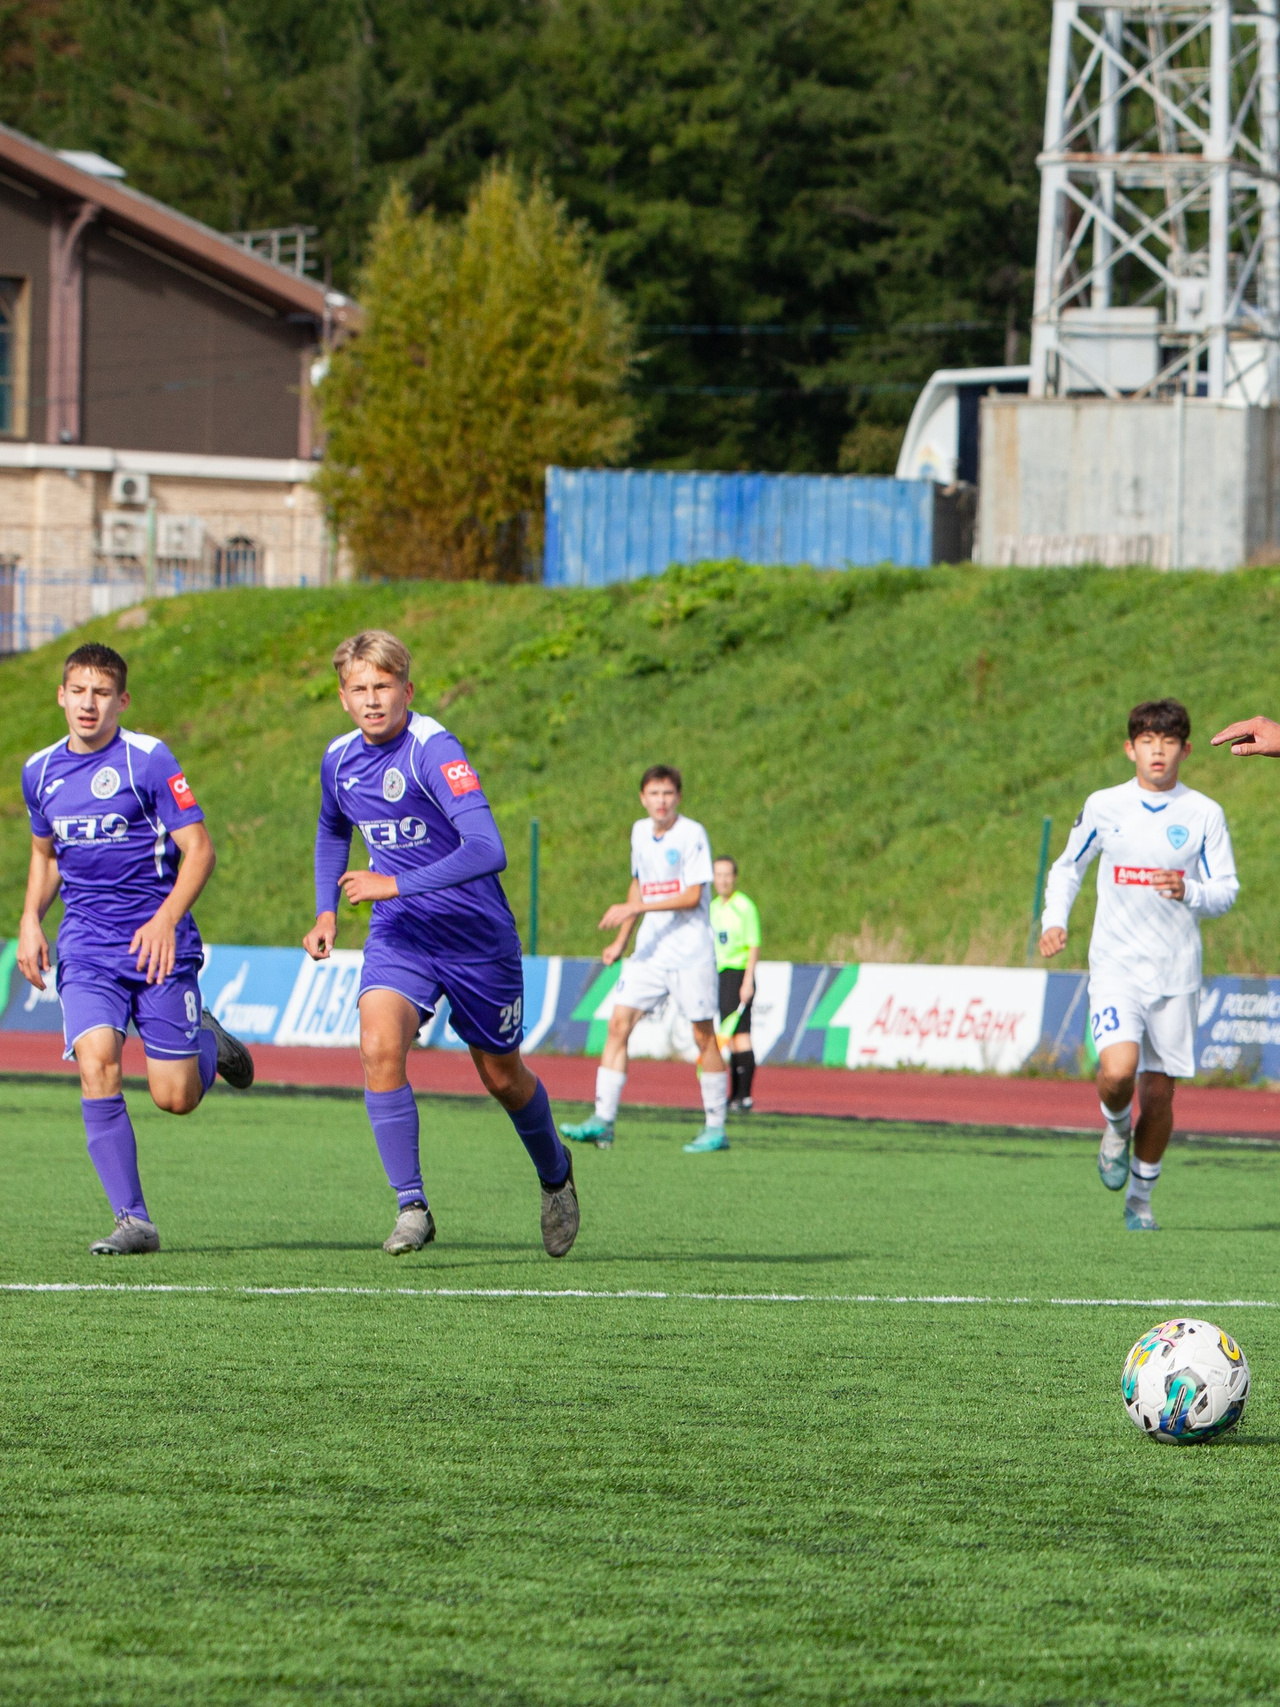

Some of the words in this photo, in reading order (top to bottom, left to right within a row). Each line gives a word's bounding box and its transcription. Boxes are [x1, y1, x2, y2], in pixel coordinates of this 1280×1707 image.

[184, 991, 197, 1022] 8
[499, 997, 521, 1034] 29
[1092, 1006, 1120, 1041] 23
